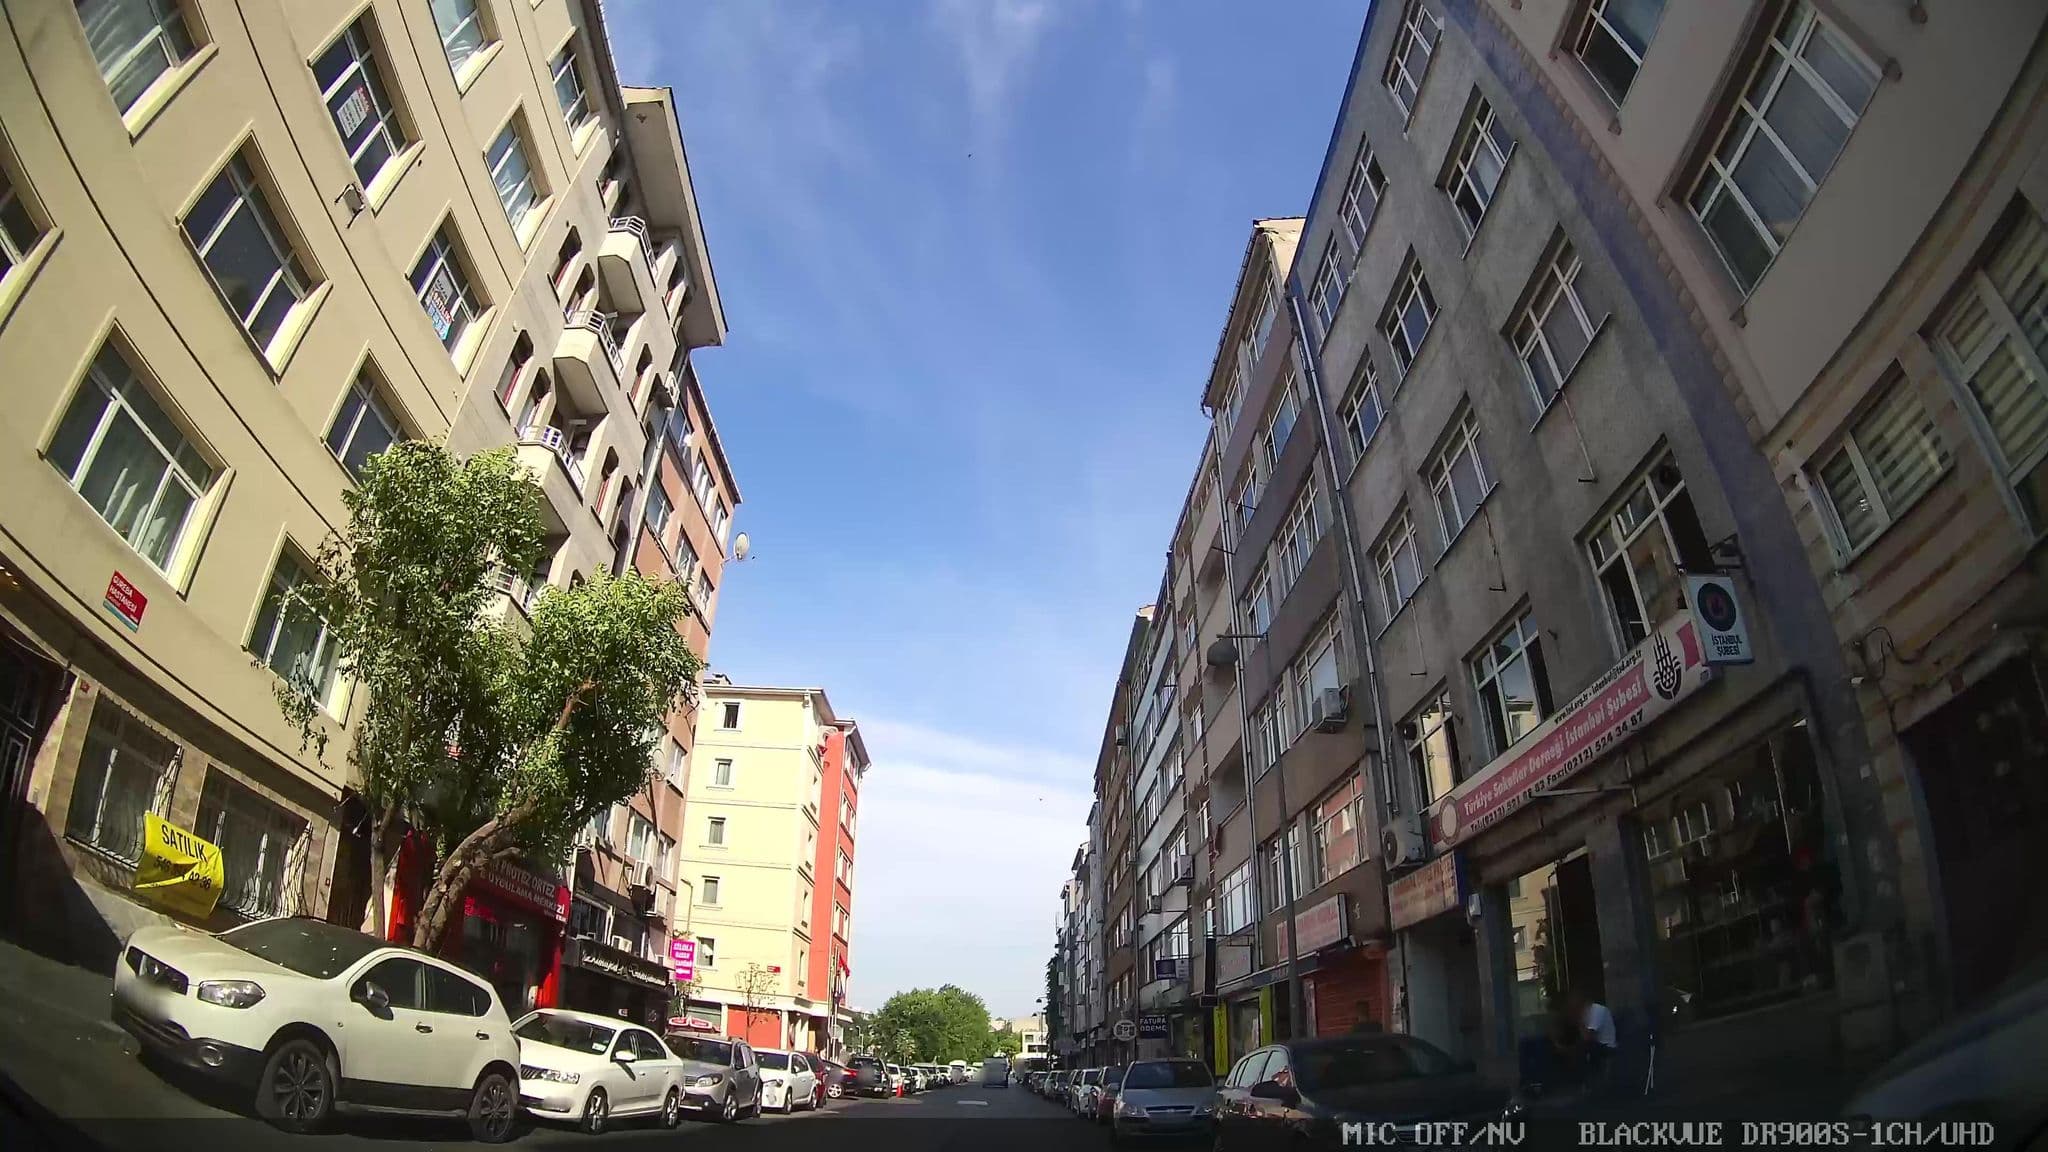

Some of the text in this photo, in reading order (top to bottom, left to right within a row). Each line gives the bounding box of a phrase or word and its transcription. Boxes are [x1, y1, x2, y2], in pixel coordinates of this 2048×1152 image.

[1464, 790, 1494, 816] Türkiye
[1493, 767, 1528, 799] Sakatlar
[1528, 735, 1564, 774] Derneği
[1606, 674, 1643, 720] Şubesi
[161, 823, 209, 864] SATILIK
[531, 875, 556, 898] ORTEZ
